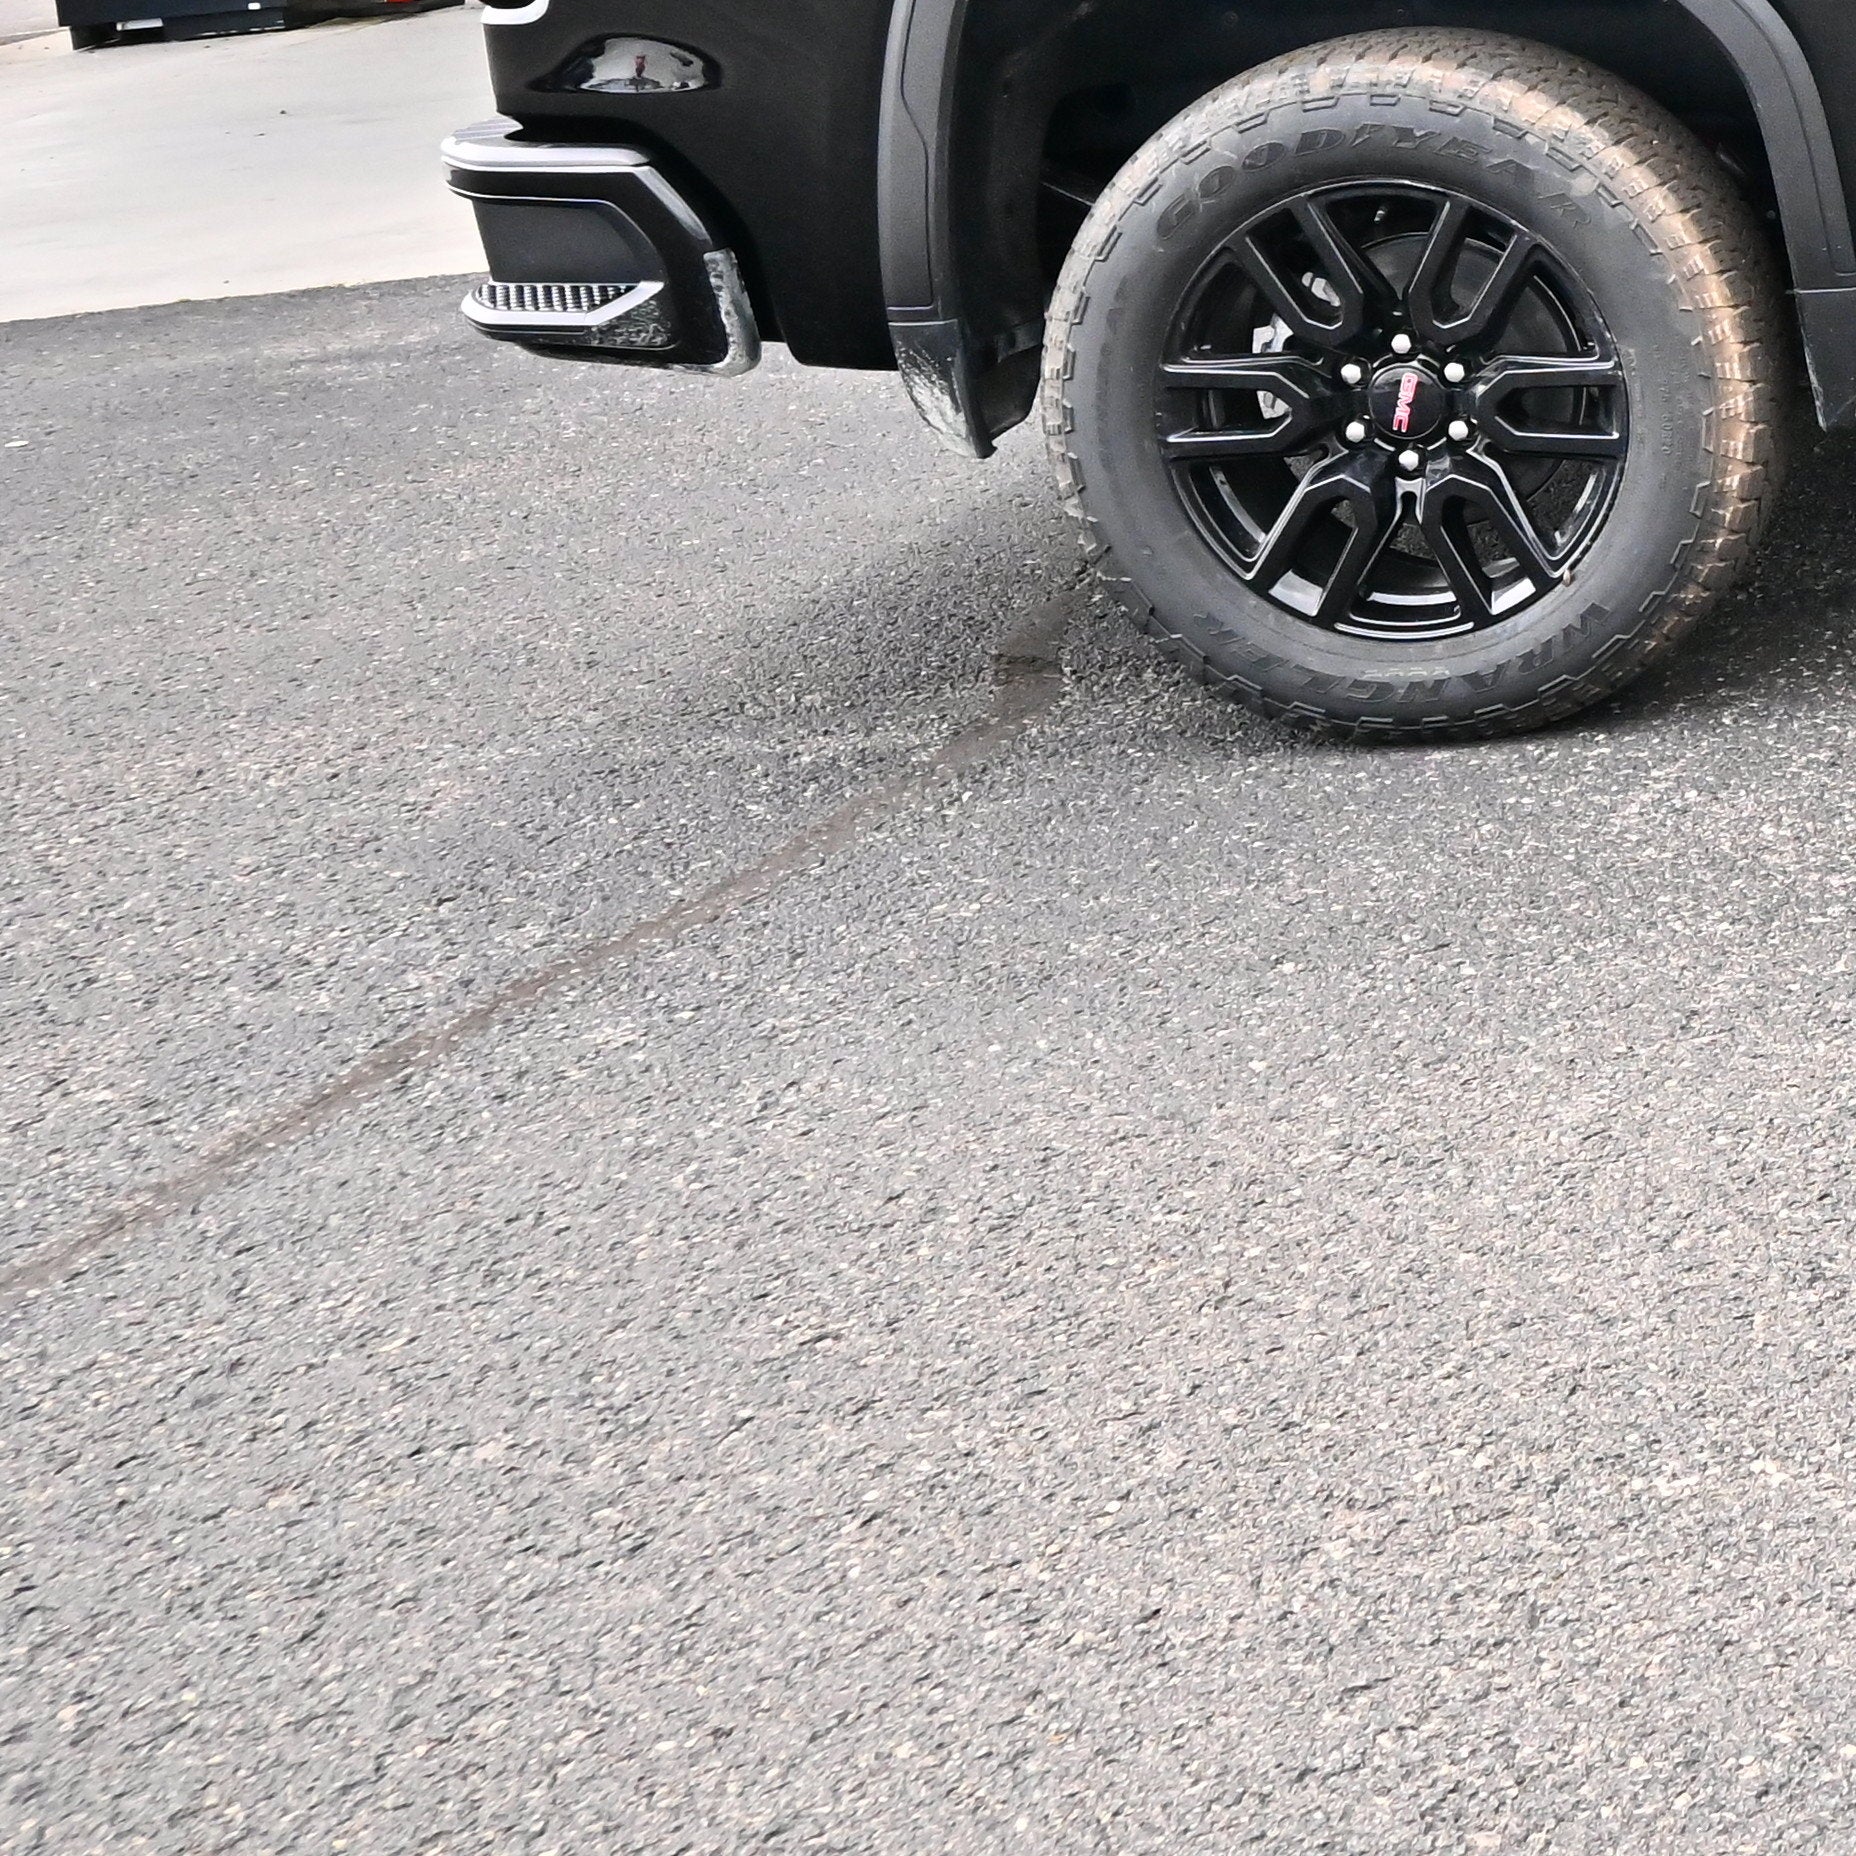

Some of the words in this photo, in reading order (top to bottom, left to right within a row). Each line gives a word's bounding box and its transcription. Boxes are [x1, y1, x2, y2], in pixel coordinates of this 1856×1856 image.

[1155, 122, 1594, 240] GOODYEAR
[1392, 372, 1419, 433] GMC
[1192, 600, 1614, 704] WRANGLER
